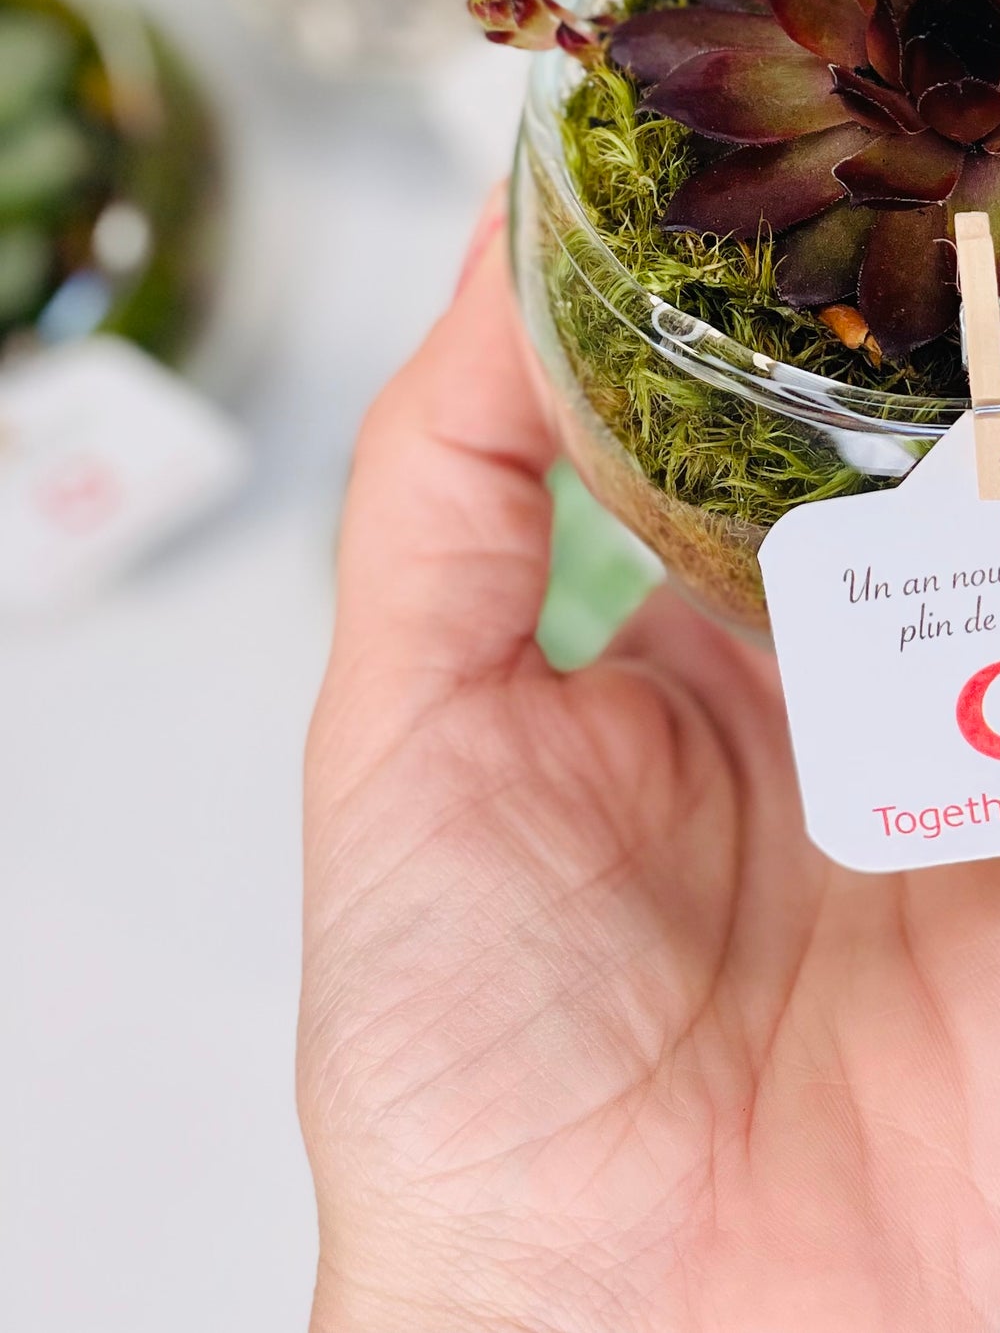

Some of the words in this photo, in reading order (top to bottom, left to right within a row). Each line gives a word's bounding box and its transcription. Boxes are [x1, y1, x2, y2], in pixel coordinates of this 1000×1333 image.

[842, 566, 892, 604] Un
[902, 575, 940, 596] an
[899, 604, 954, 653] plin
[964, 595, 997, 634] de
